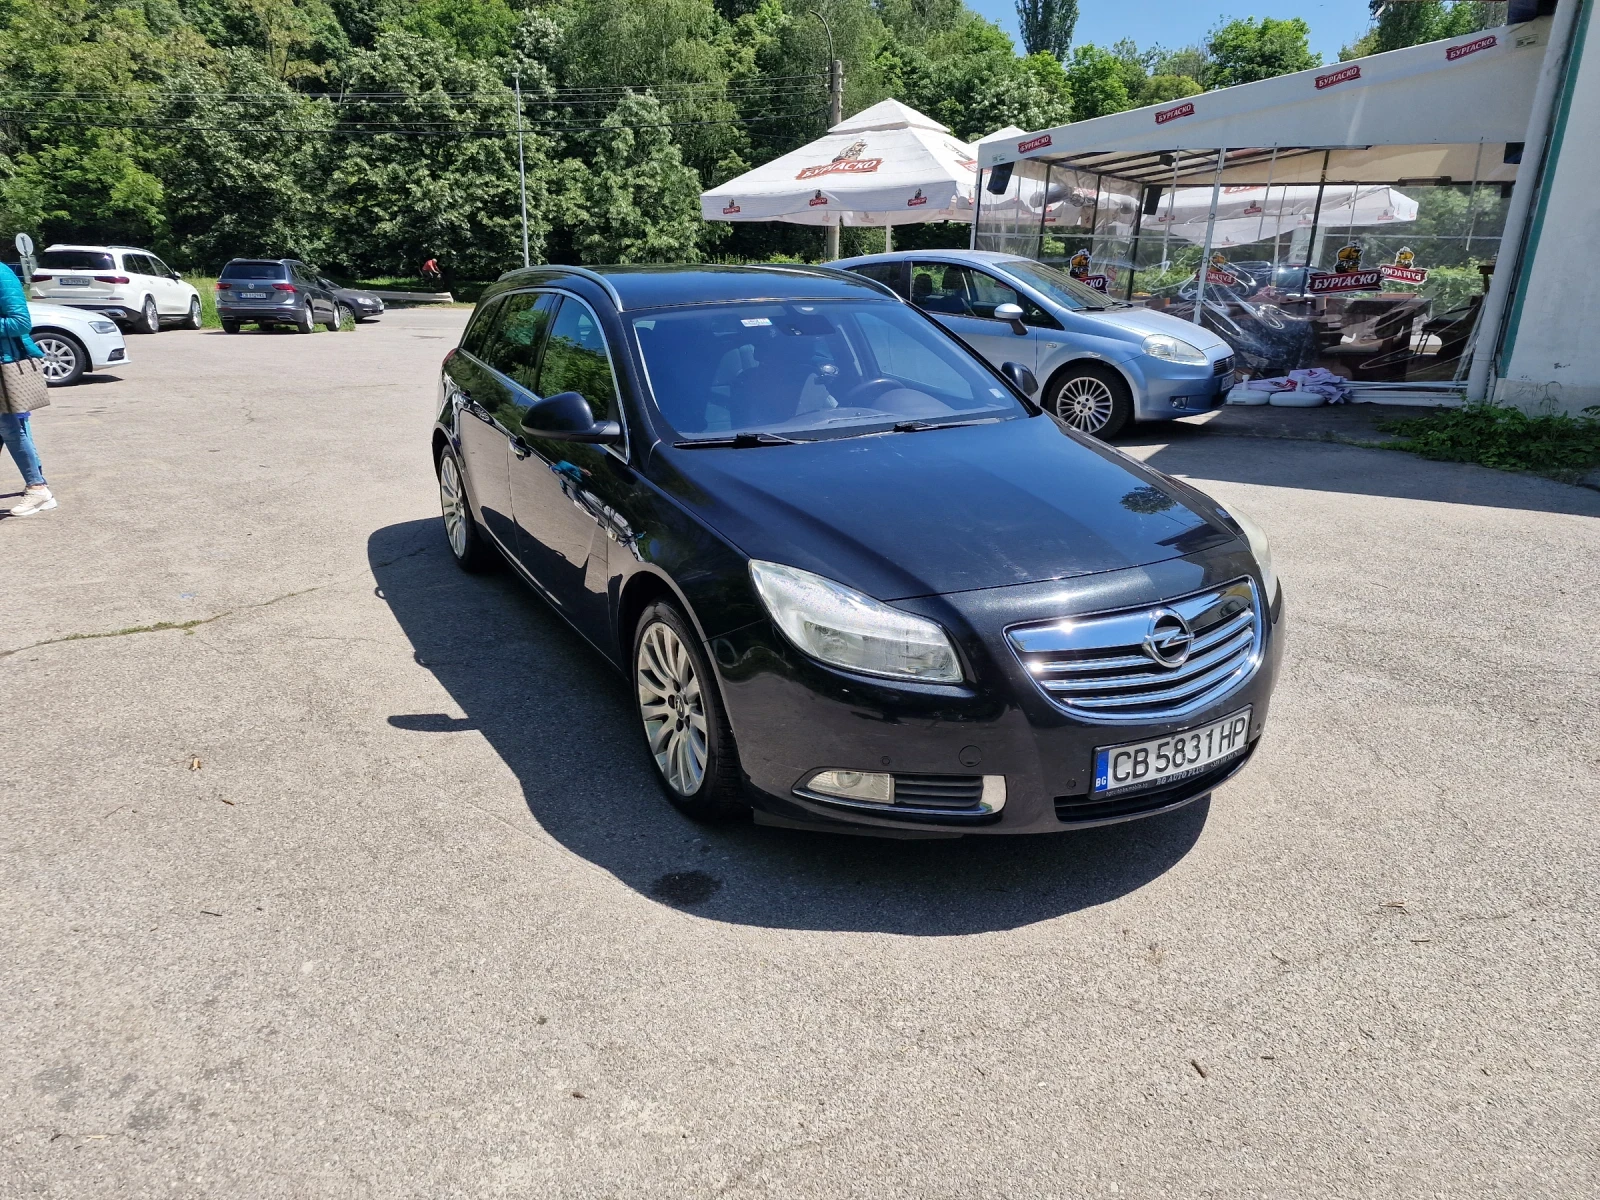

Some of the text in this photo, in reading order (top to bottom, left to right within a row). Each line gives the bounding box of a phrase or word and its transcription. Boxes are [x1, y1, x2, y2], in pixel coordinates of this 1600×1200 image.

[1450, 38, 1493, 58] БУРГАСКО
[1319, 68, 1357, 87] БУРГАСКО
[1158, 104, 1191, 122] БУРГАСКО
[1020, 136, 1049, 151] БУРГАСКО
[802, 161, 877, 177] БУРГАСКО
[1314, 273, 1377, 289] БУРГАСКО
[1113, 747, 1149, 783] CB
[1155, 729, 1214, 772] 5831
[1218, 717, 1246, 754] HP
[1095, 775, 1106, 787] BG
[1168, 771, 1186, 782] AUTO
